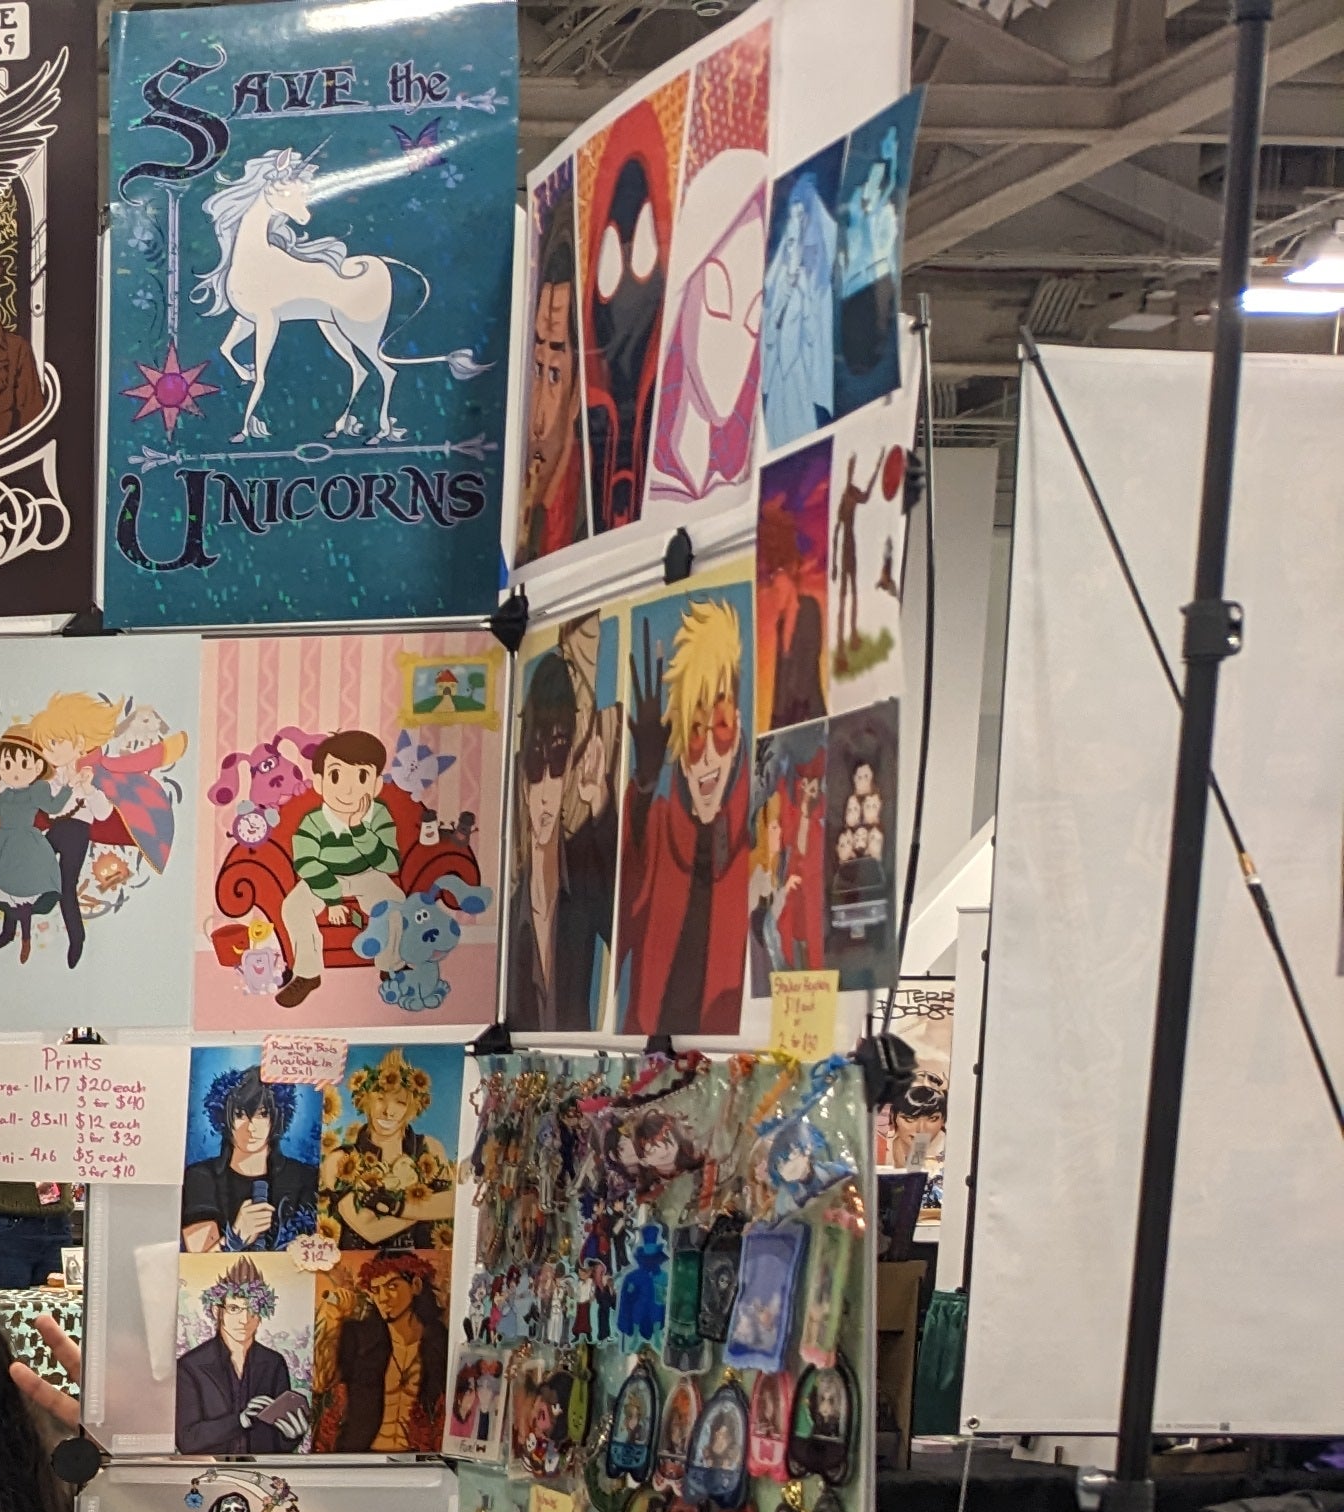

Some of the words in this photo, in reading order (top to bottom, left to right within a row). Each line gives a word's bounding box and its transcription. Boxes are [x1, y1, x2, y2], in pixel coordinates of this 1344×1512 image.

[388, 61, 449, 116] the
[116, 467, 486, 571] UNICORNS
[42, 1047, 102, 1071] Prints
[77, 1075, 111, 1093] $20
[112, 1081, 146, 1094] each
[115, 1096, 145, 1111] $40
[75, 1112, 105, 1130] $12
[109, 1119, 140, 1130] each
[112, 1131, 141, 1146] $30
[73, 1147, 94, 1164] $5
[112, 1165, 135, 1179] $10
